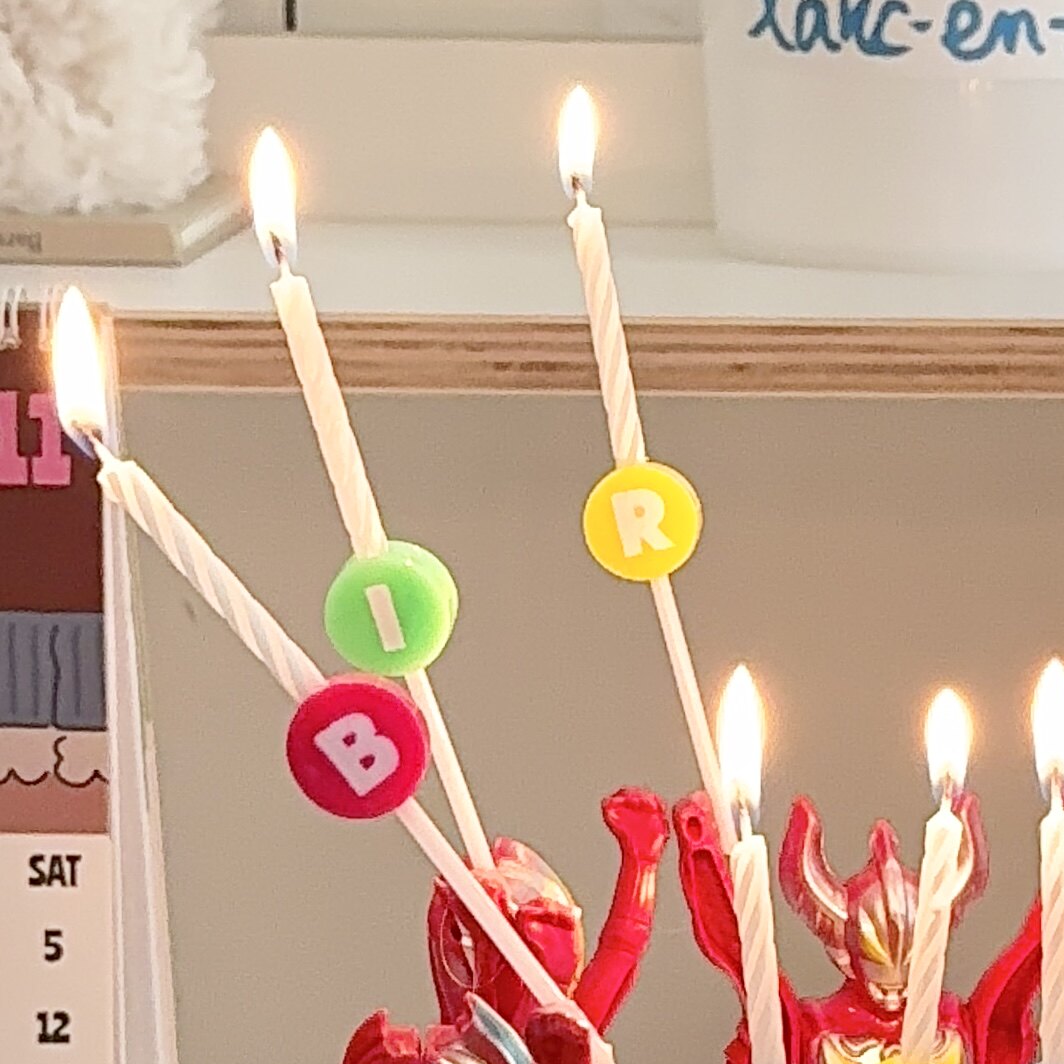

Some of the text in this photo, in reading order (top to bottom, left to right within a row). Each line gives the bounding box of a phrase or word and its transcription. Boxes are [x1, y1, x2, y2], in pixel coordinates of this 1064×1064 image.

[611, 487, 677, 559] R
[313, 711, 400, 798] B
[27, 854, 82, 888] SAT
[43, 929, 64, 962] 5
[36, 1011, 71, 1044] 12
